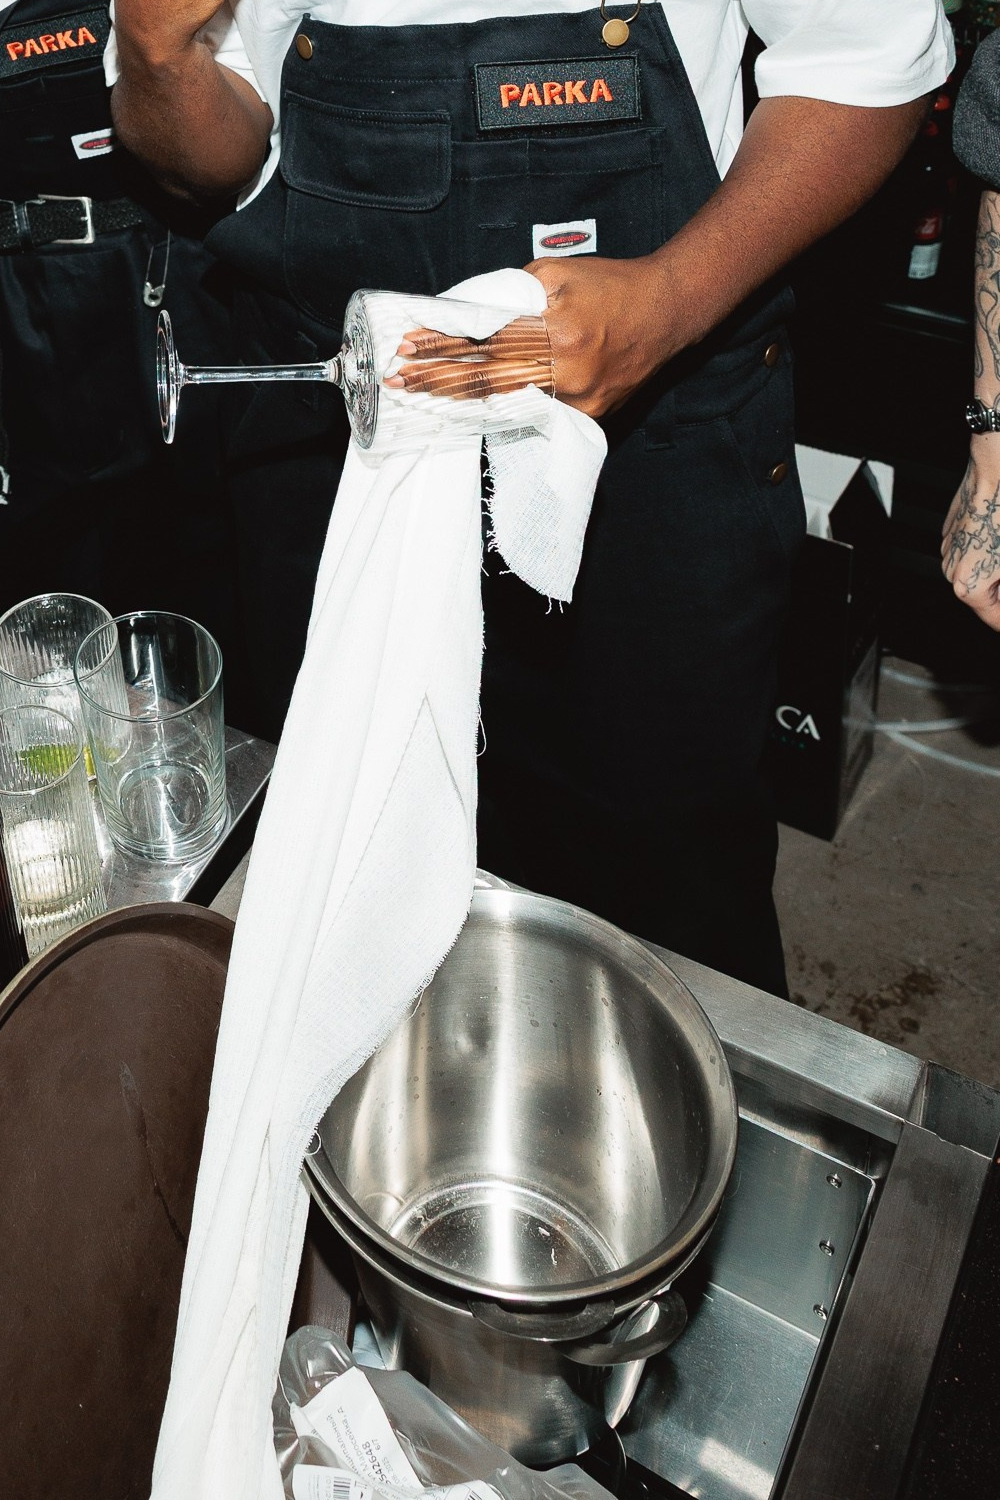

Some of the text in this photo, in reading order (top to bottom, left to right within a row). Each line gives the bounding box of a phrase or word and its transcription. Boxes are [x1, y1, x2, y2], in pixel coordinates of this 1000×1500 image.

[6, 26, 97, 61] PARKA
[500, 78, 614, 109] PARKA
[775, 705, 821, 742] CA
